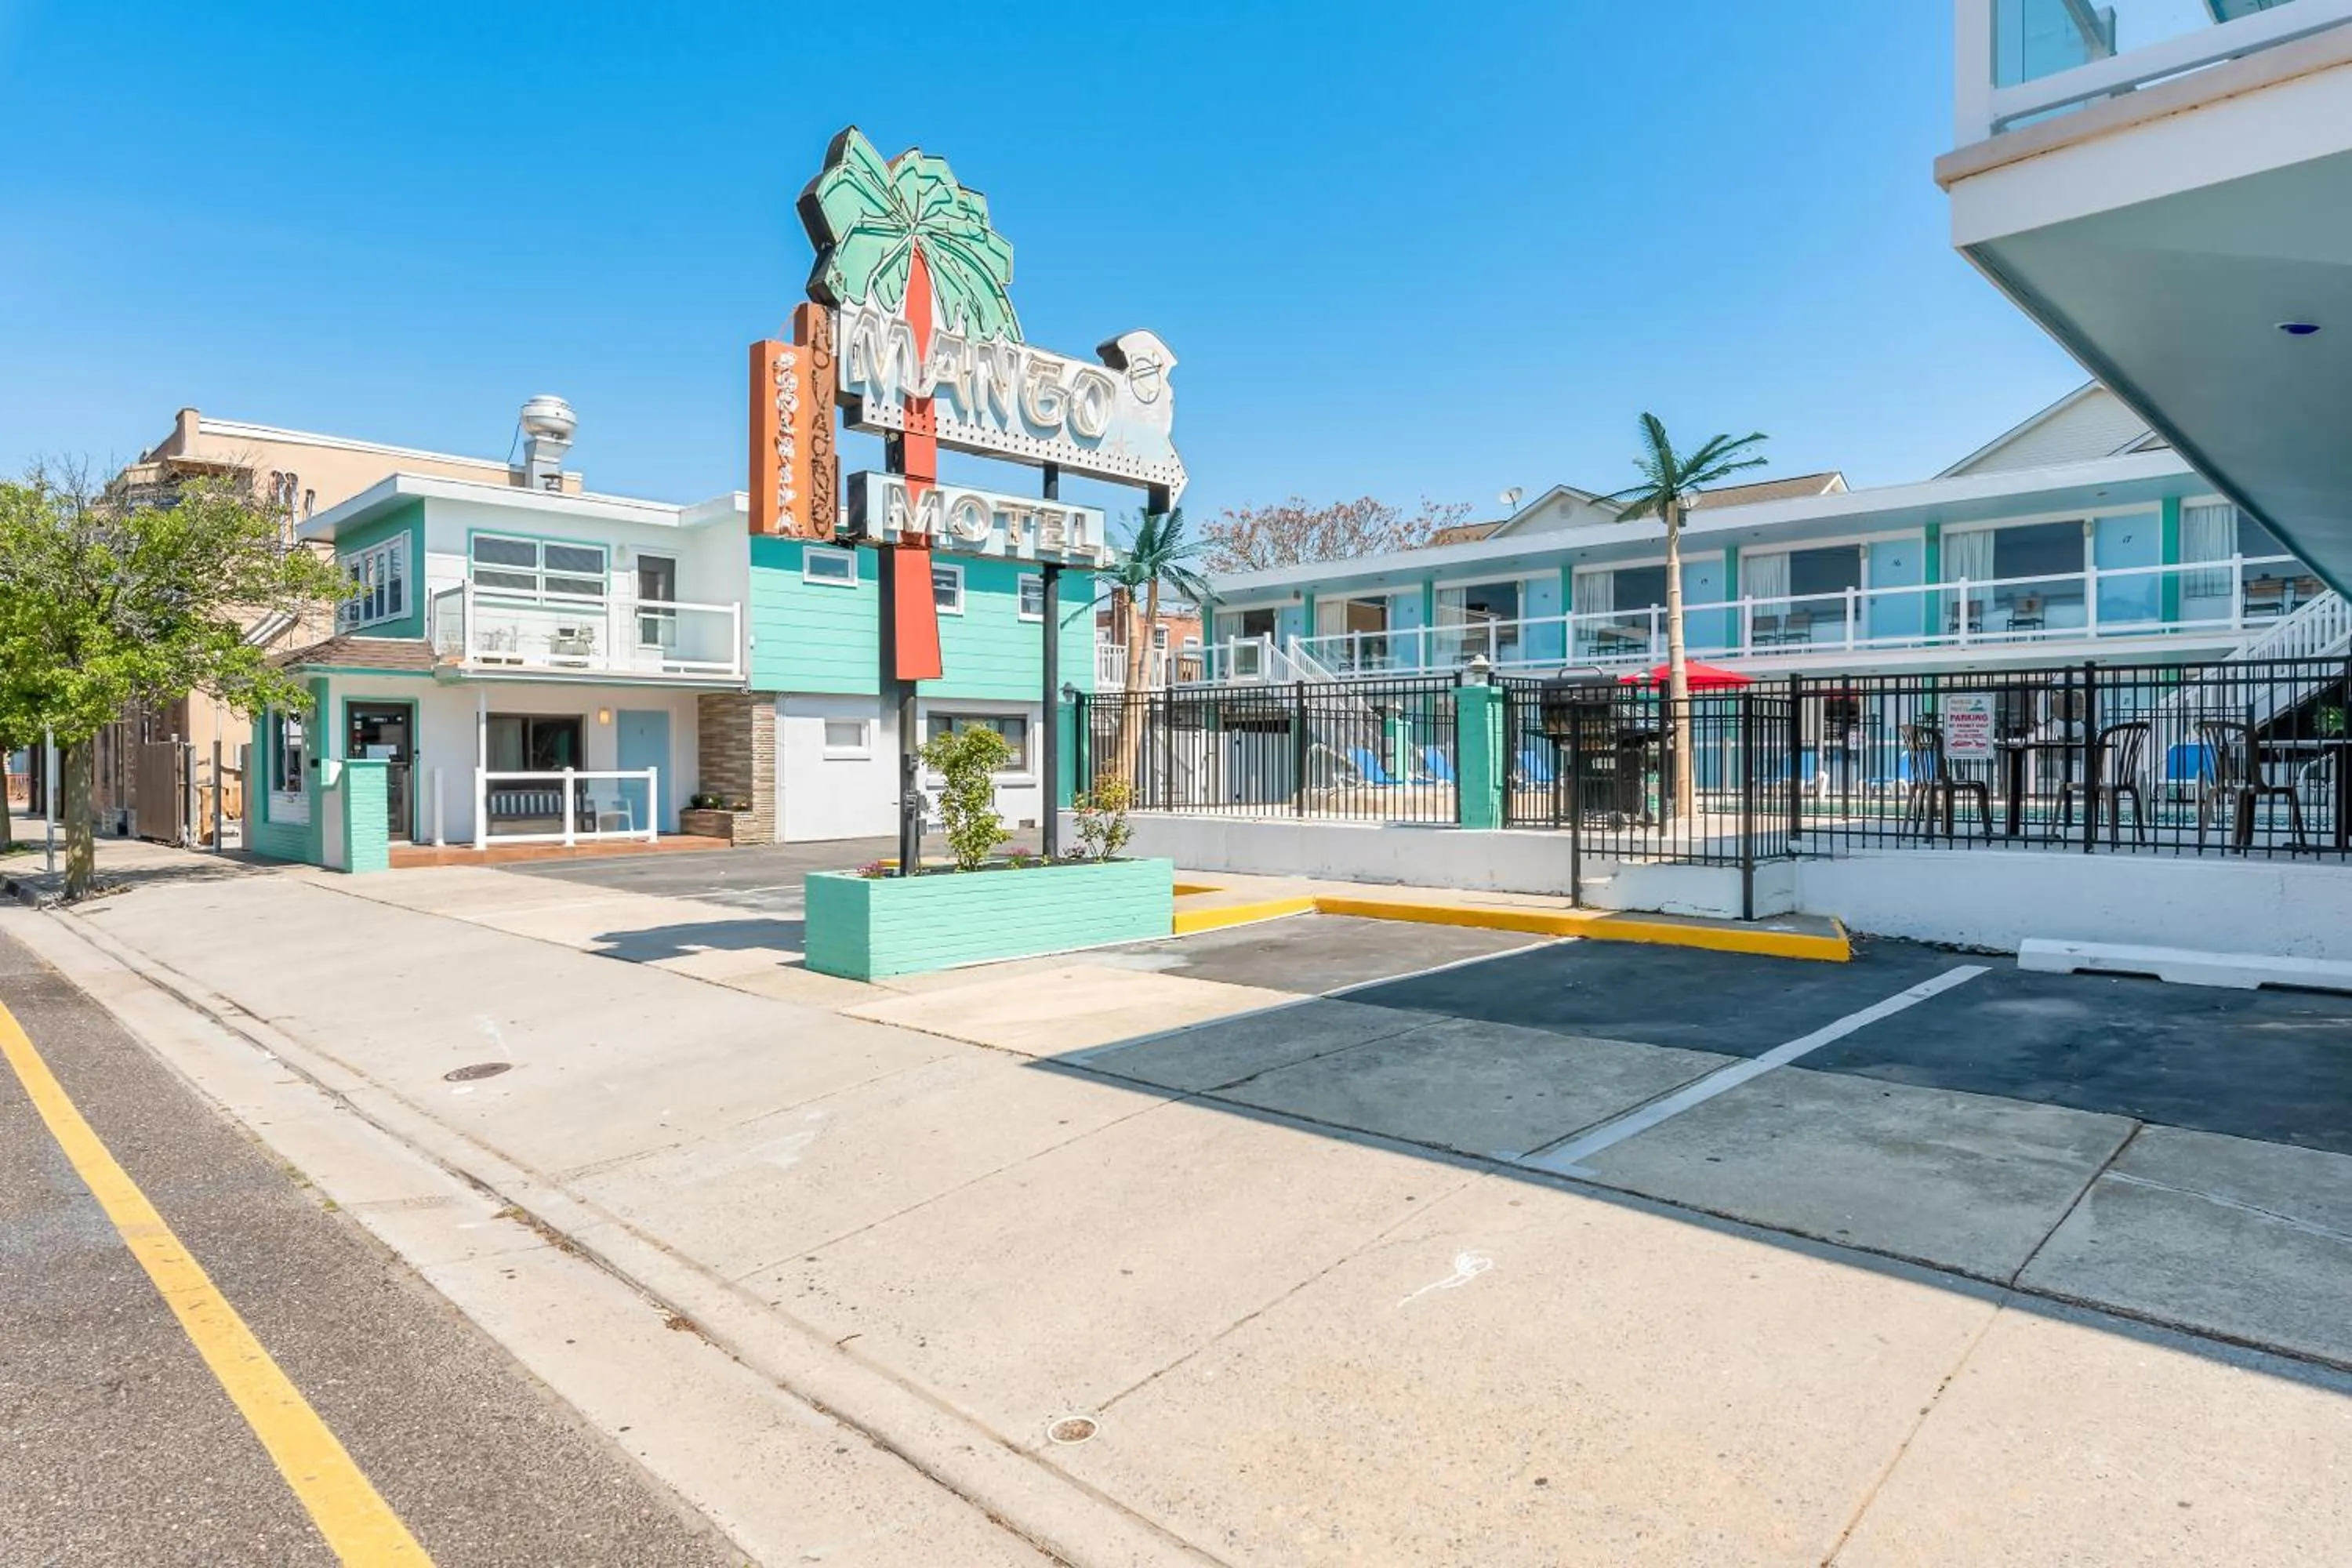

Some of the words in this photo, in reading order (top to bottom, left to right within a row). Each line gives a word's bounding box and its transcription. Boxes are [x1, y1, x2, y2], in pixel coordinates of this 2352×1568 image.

[848, 307, 1117, 439] MANGO
[883, 482, 1102, 562] MOTEL
[1950, 713, 1989, 722] PARKING
